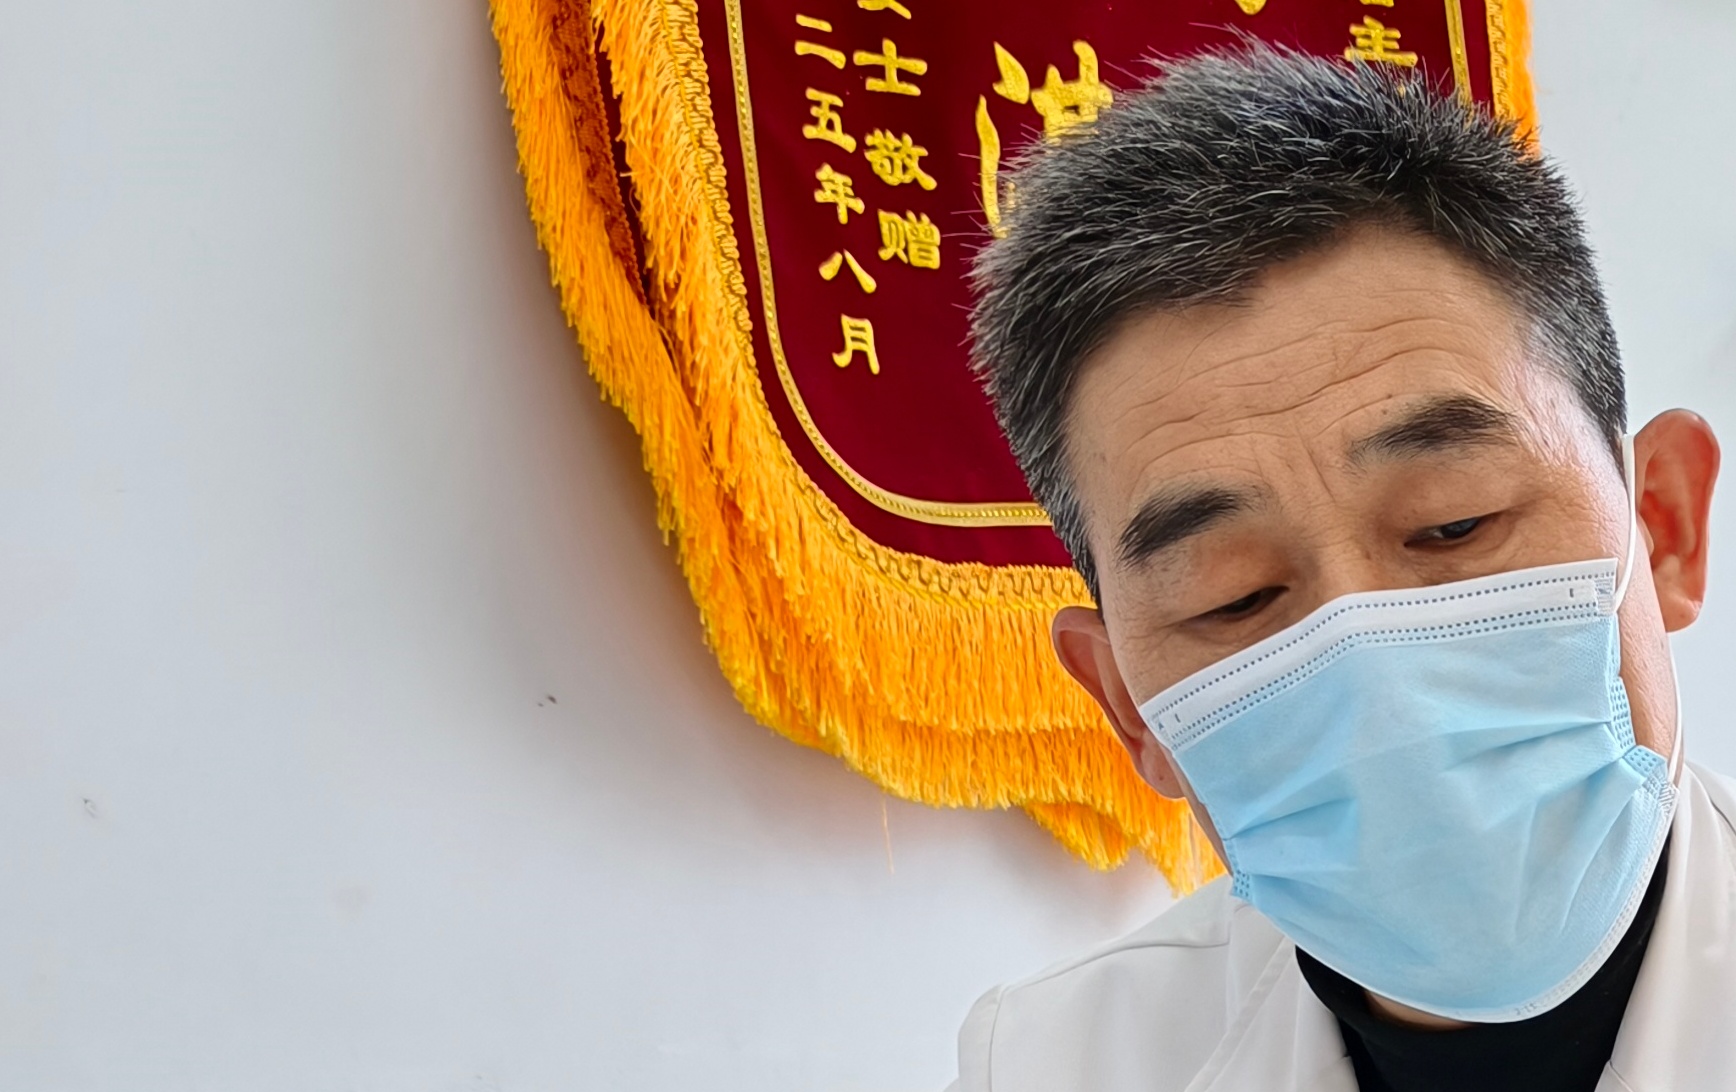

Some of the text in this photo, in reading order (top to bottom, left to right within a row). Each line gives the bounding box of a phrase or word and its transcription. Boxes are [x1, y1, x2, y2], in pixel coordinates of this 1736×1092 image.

[794, 13, 881, 376] 二五年八月
[852, 0, 942, 271] 士敬赠
